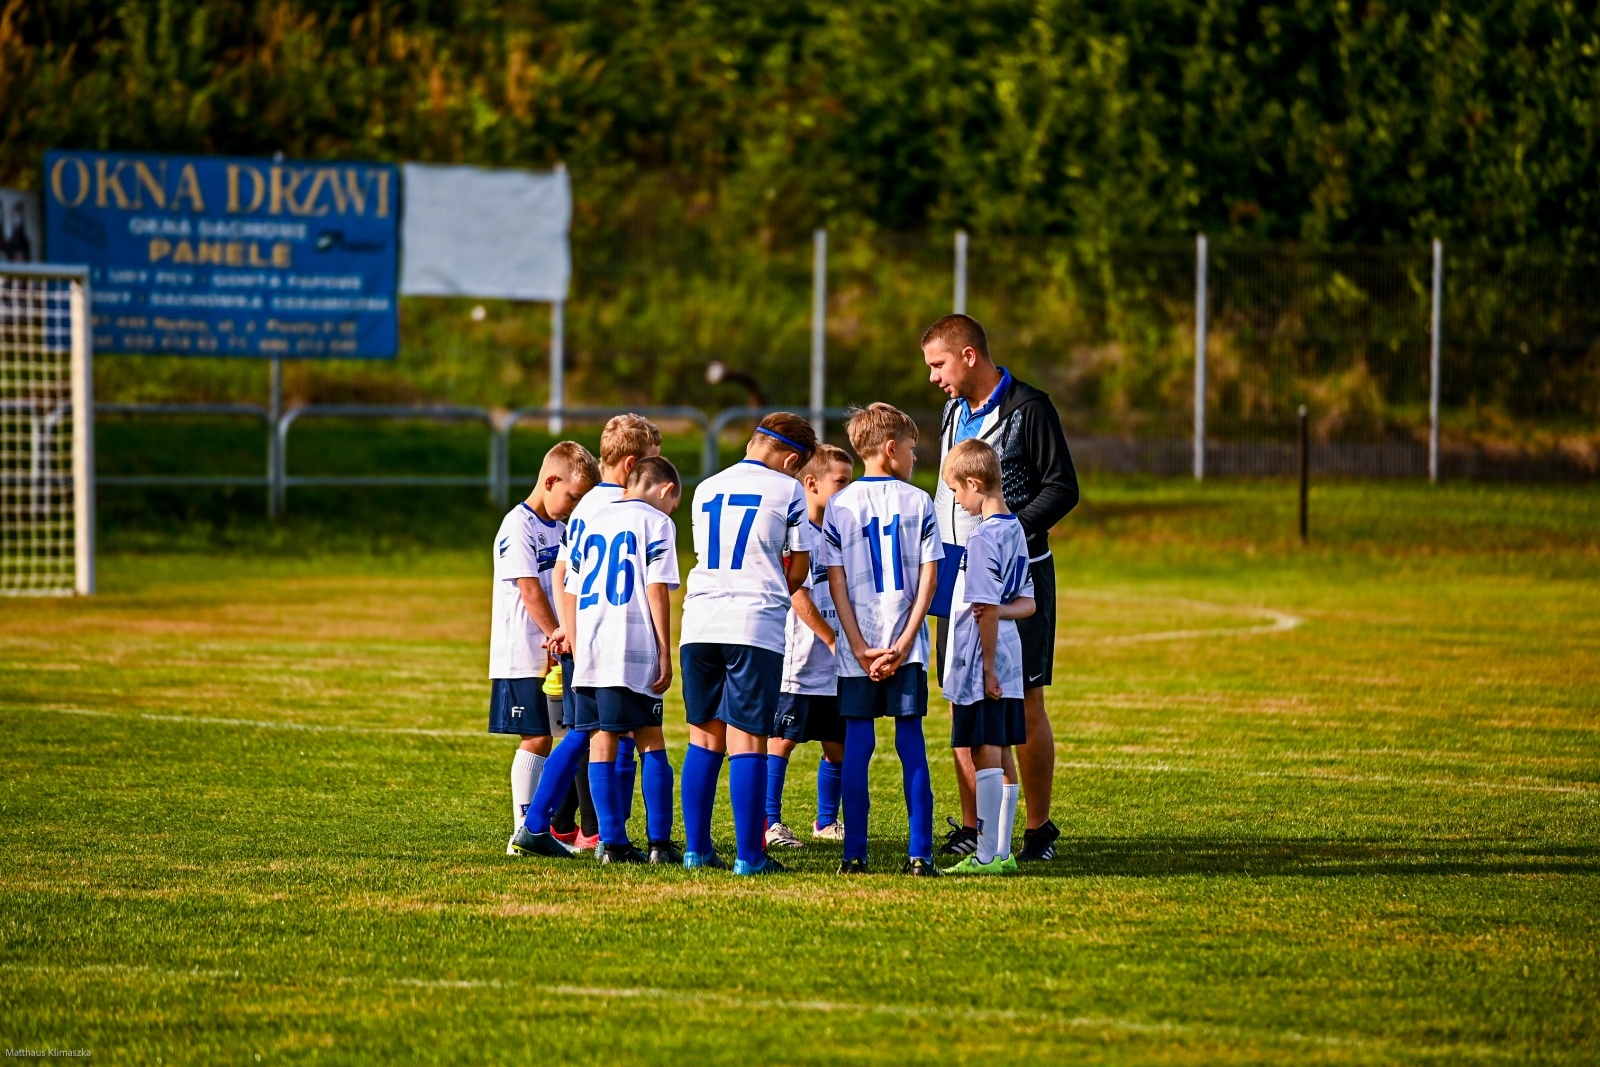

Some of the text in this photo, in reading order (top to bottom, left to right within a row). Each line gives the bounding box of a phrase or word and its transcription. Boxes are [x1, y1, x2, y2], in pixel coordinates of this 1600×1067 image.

[50, 156, 391, 219] OKNA DRZWI
[149, 238, 292, 269] PANELE
[702, 493, 762, 570] 17
[862, 514, 904, 593] 11
[579, 531, 637, 611] 26
